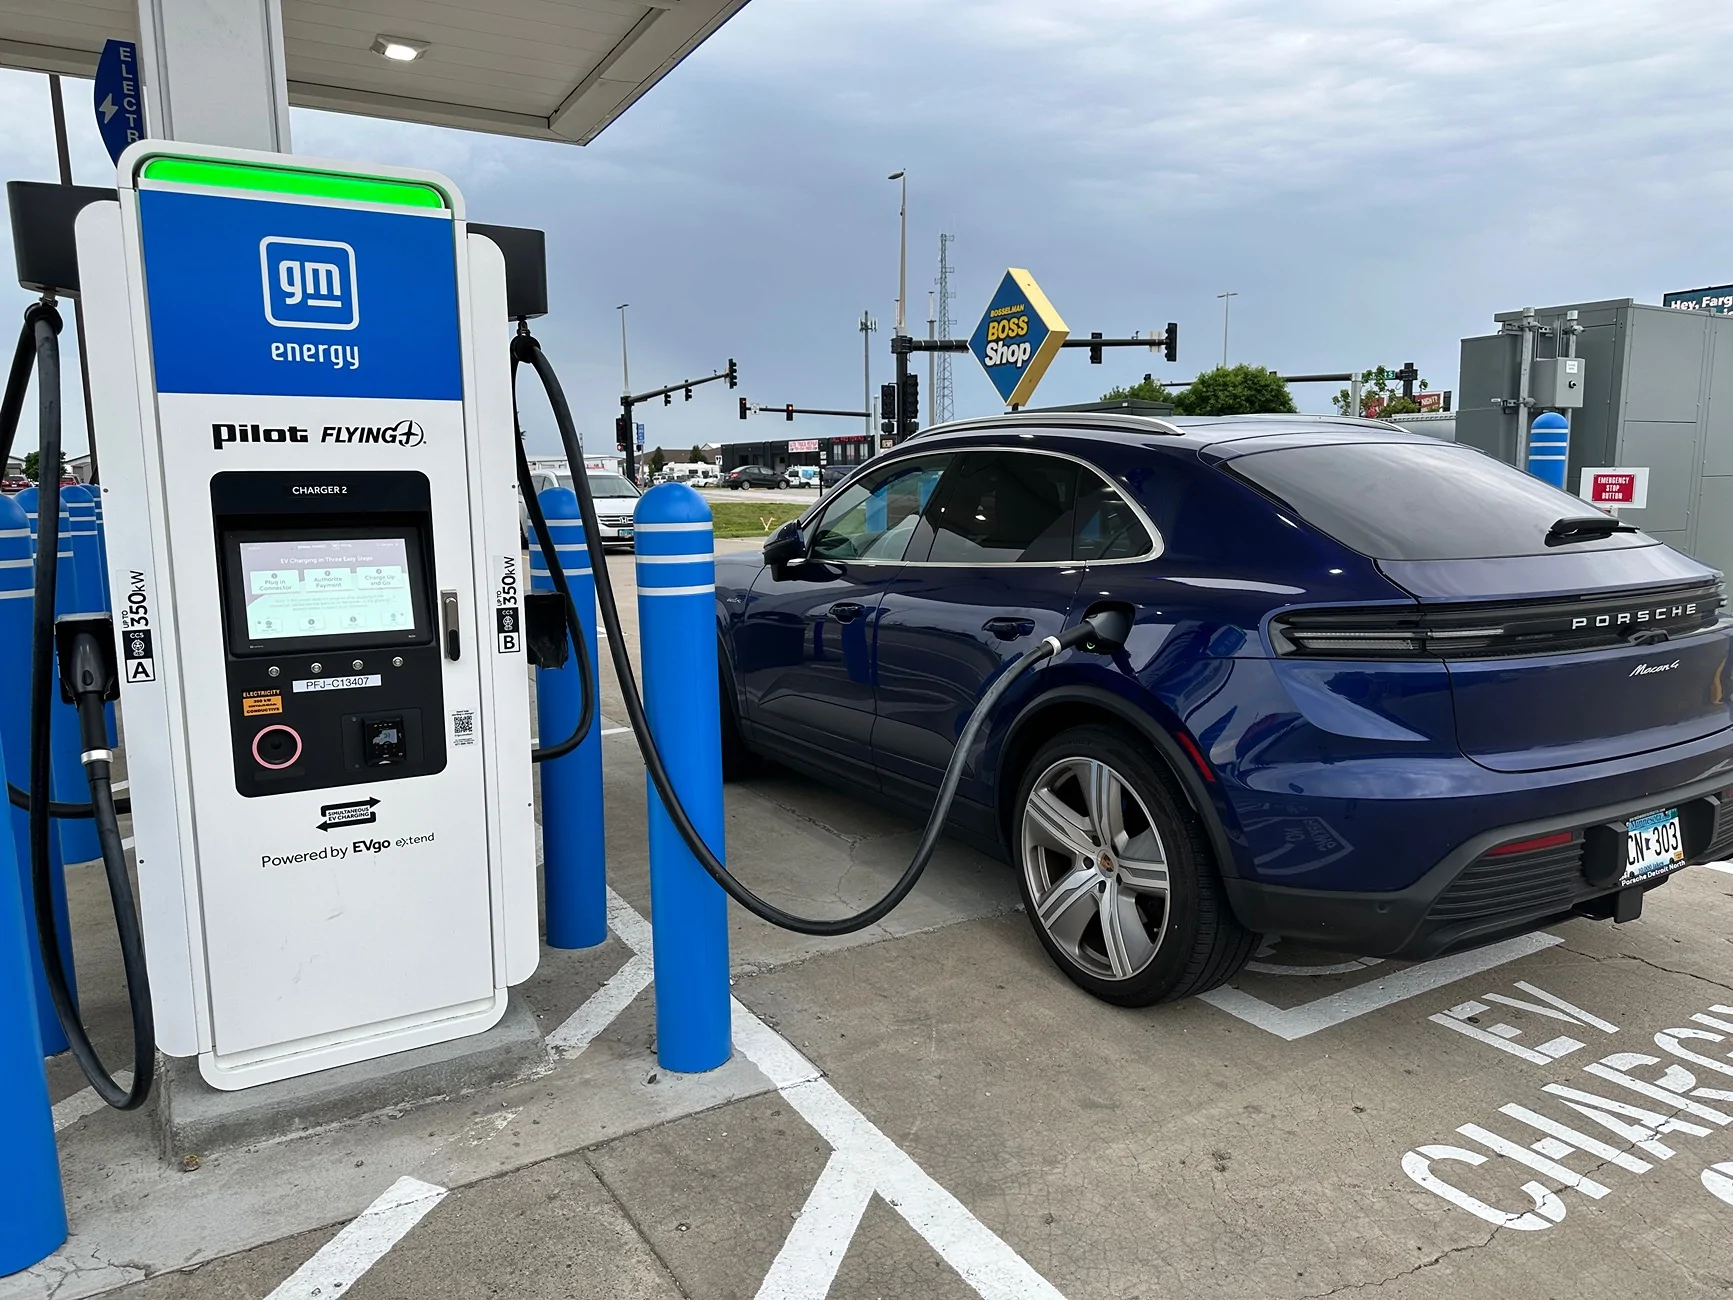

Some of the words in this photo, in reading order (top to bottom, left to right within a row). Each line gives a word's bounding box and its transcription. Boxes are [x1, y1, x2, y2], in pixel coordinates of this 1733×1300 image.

[279, 260, 342, 307] gm
[990, 304, 1024, 317] BOSSELMAN
[988, 316, 1028, 341] BOSS
[271, 342, 359, 369] energy
[984, 341, 1031, 367] Shop
[321, 426, 398, 444] FLYING
[292, 486, 340, 494] CHARGER
[502, 556, 517, 605] 350kW
[128, 570, 149, 627] 350kW
[122, 610, 128, 619] TO
[122, 620, 129, 628] UP
[1571, 603, 1697, 629] PORSCHE
[503, 635, 515, 650] B
[132, 661, 150, 679] A
[1629, 663, 1670, 677] Macan
[306, 677, 369, 689] PFJ-C13407
[328, 807, 369, 816] SIMULTANEOUS
[337, 812, 369, 821] CHARGING
[1653, 821, 1679, 856] 303
[262, 847, 328, 867] Powered
[330, 846, 349, 859] by
[352, 839, 391, 853] EVgo
[1621, 874, 1647, 887] Porsche
[1647, 865, 1669, 878] Detroit
[1669, 860, 1686, 871] North
[1428, 980, 1621, 1066] EV
